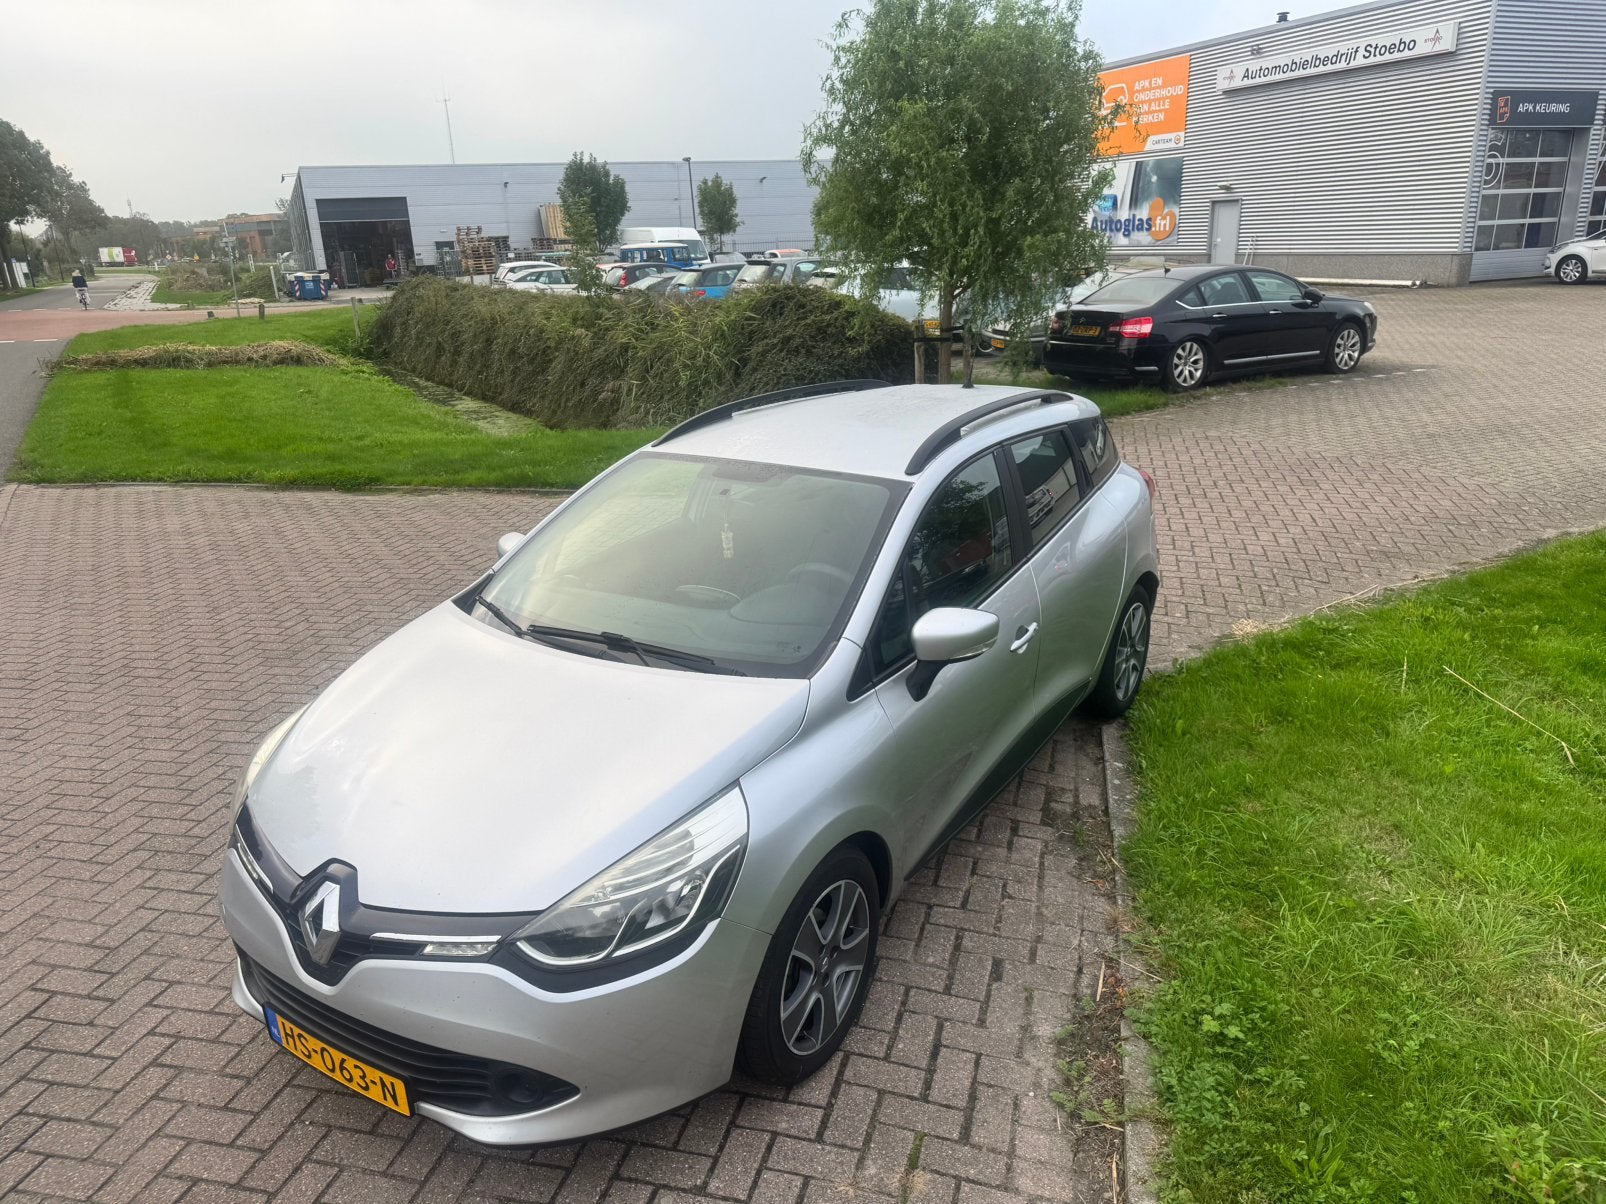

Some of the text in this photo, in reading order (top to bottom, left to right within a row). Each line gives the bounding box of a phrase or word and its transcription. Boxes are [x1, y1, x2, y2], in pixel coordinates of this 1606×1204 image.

[1241, 38, 1417, 82] Automobielbedrijf Stoebo
[1134, 77, 1163, 91] APK EN
[1133, 85, 1184, 102] ONDERHOUD
[1150, 99, 1170, 111] ALLE
[1517, 103, 1571, 113] APK KEURING
[281, 1020, 399, 1107] HS-063-N
